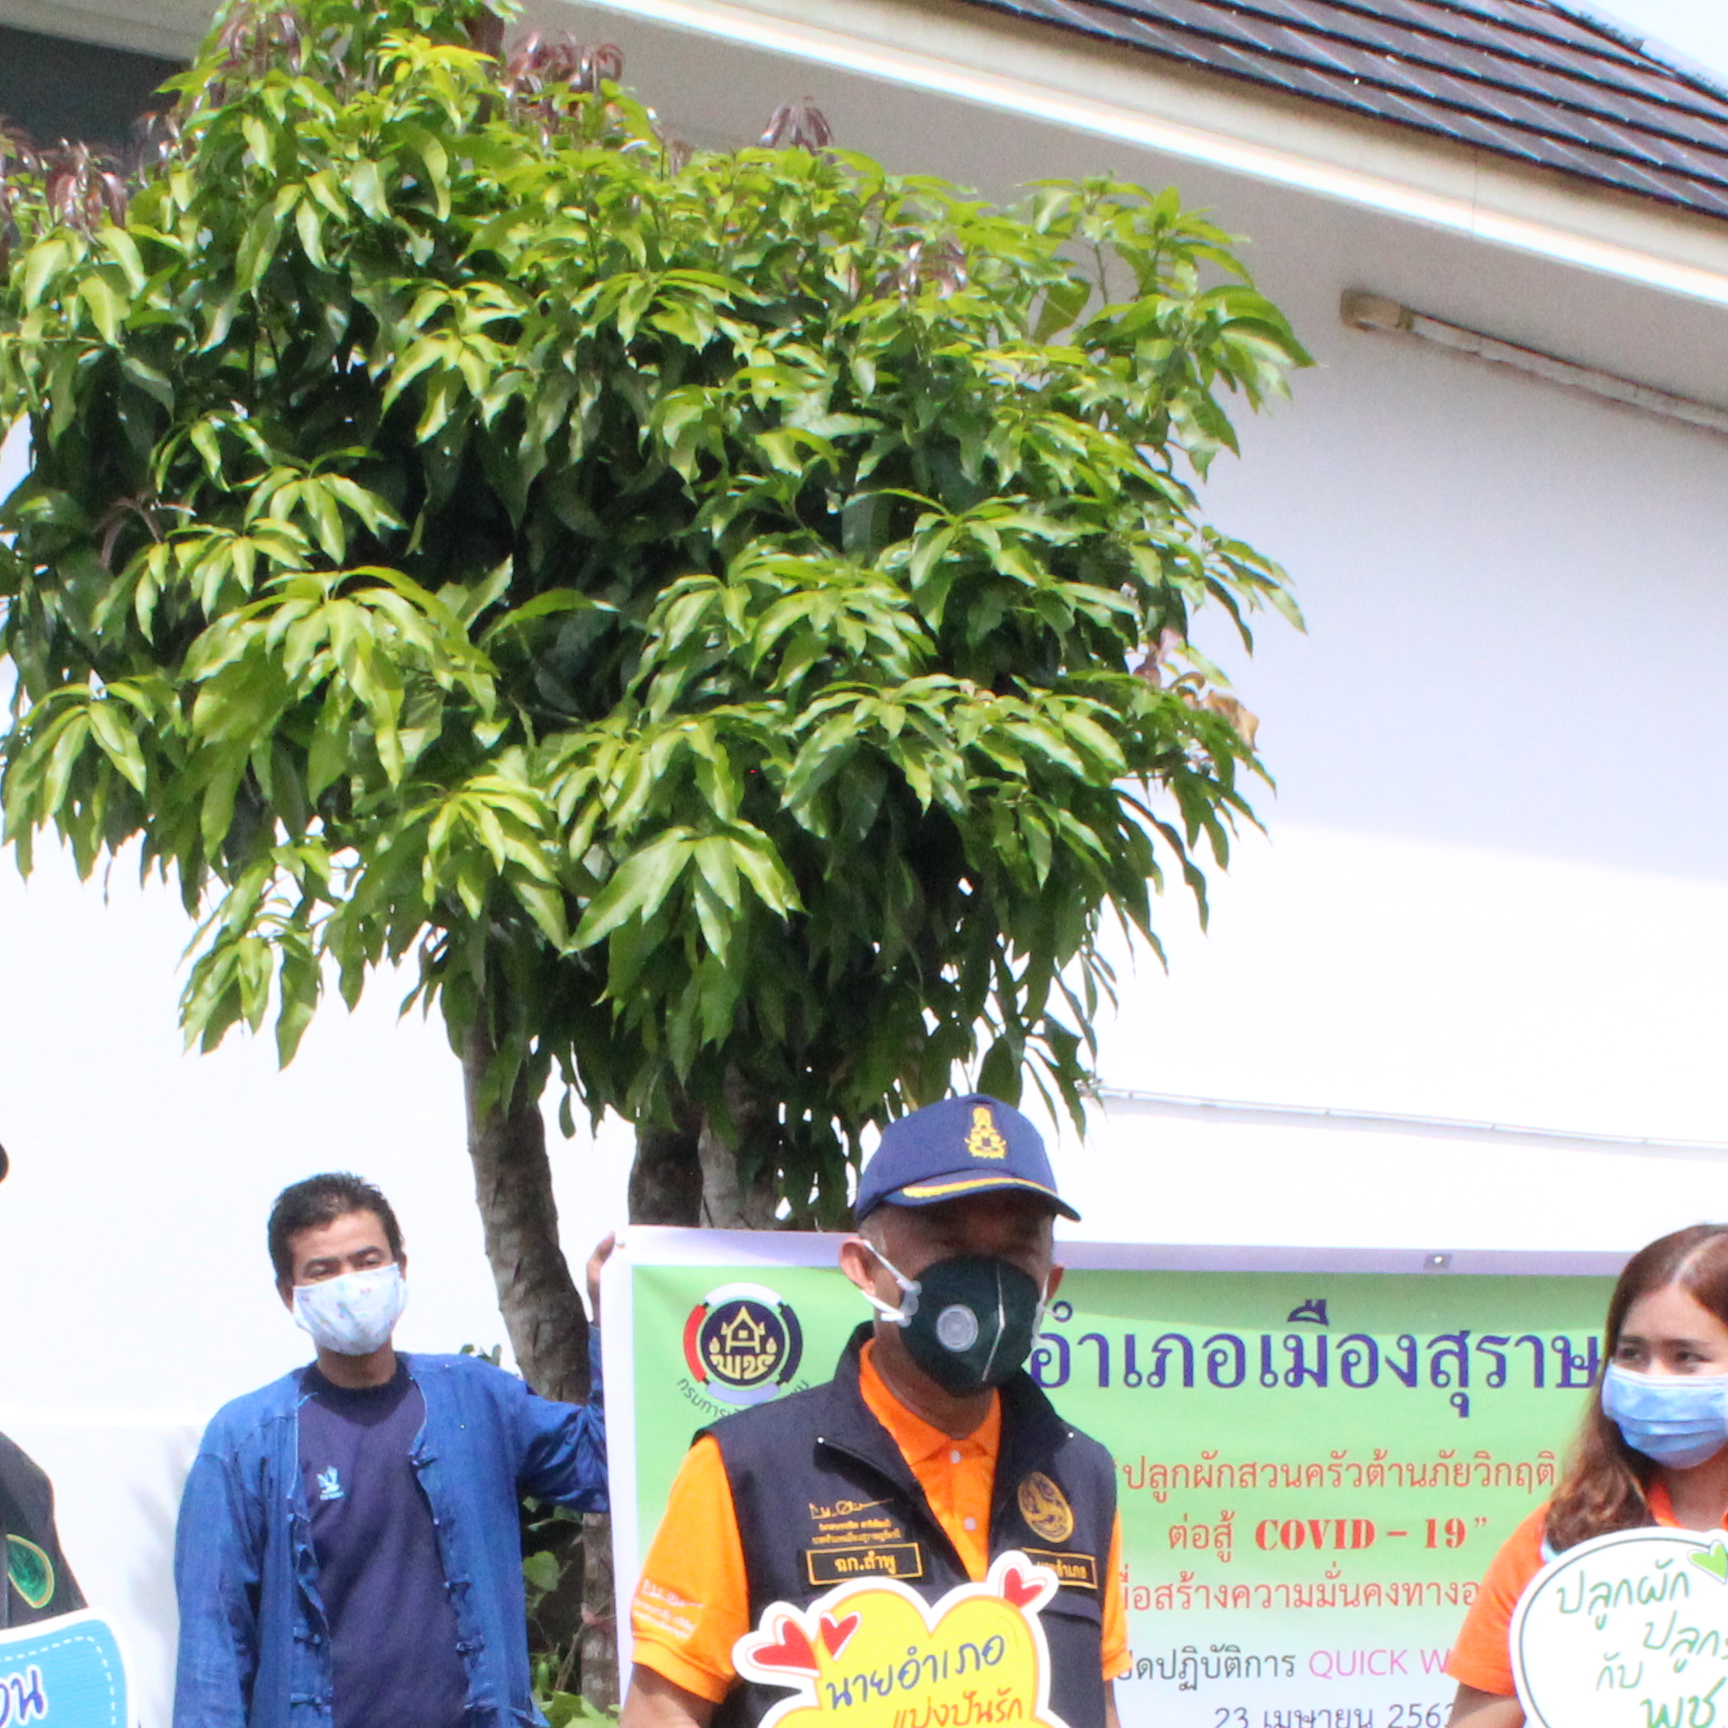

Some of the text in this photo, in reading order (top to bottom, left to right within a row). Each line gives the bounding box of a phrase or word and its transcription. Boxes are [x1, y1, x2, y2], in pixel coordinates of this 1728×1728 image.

[1168, 1510, 1236, 1564] ต่อสู้
[1255, 1517, 1376, 1551] COVID
[1556, 1558, 1689, 1631] ปลูกผัก
[826, 1634, 1005, 1710] นายอำเภอ
[1309, 1649, 1408, 1680] QUICK
[1596, 1652, 1644, 1691] กับ
